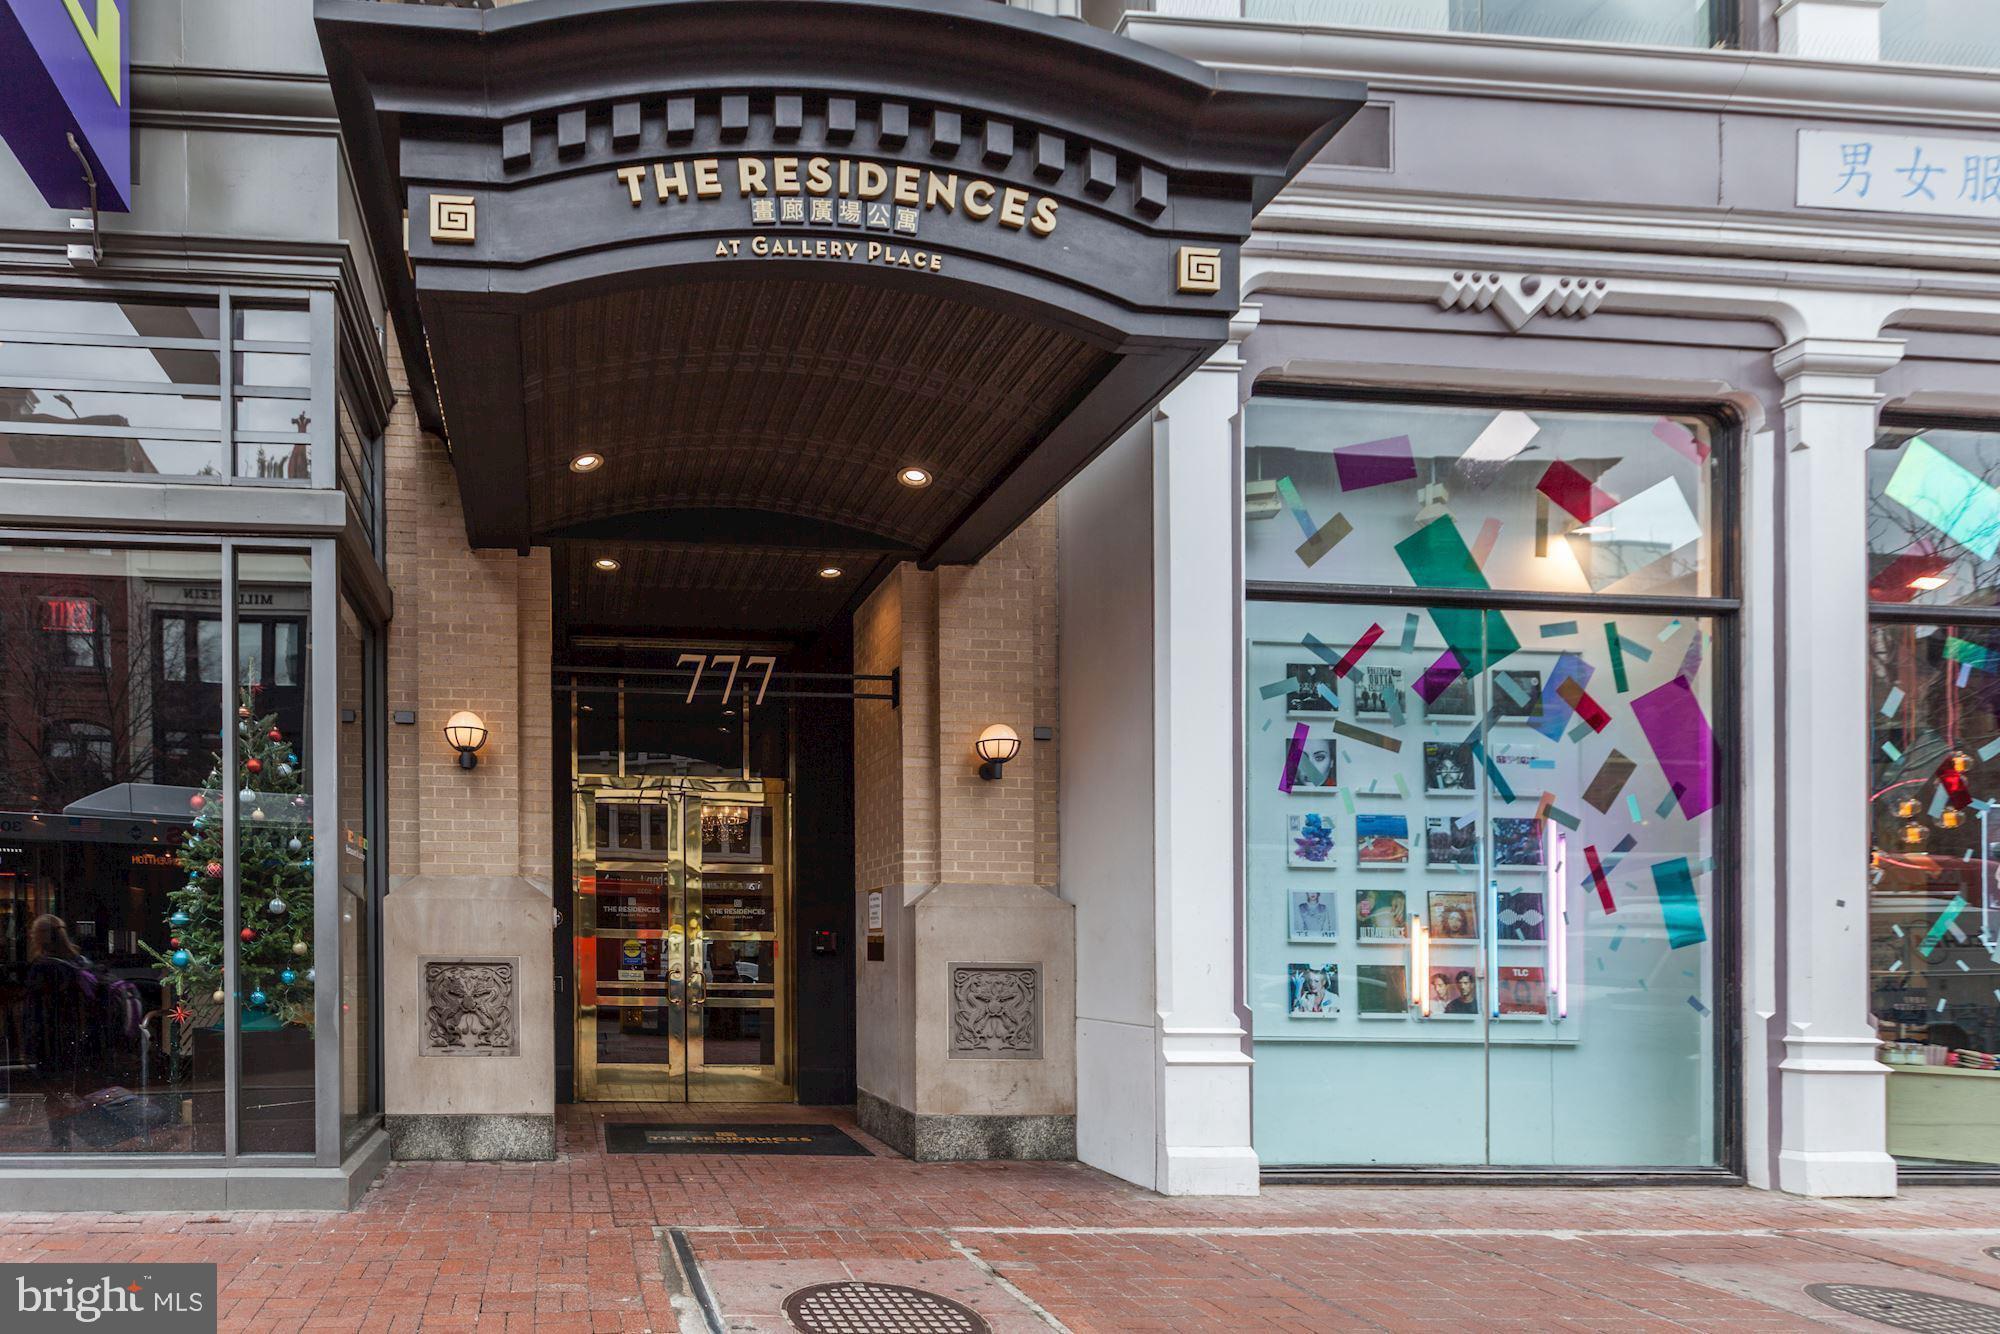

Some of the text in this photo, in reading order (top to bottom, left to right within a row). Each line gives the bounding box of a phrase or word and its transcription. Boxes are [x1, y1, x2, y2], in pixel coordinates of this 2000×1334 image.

[617, 156, 1060, 236] THE RESIDENCES
[752, 197, 919, 234] 畫廊廣場公寓
[715, 236, 943, 273] AT GALLERY PLACE
[676, 653, 777, 706] 777
[603, 905, 661, 913] THE RESIDENCES
[724, 908, 766, 916] RESIDENCES
[1512, 968, 1529, 977] TLC
